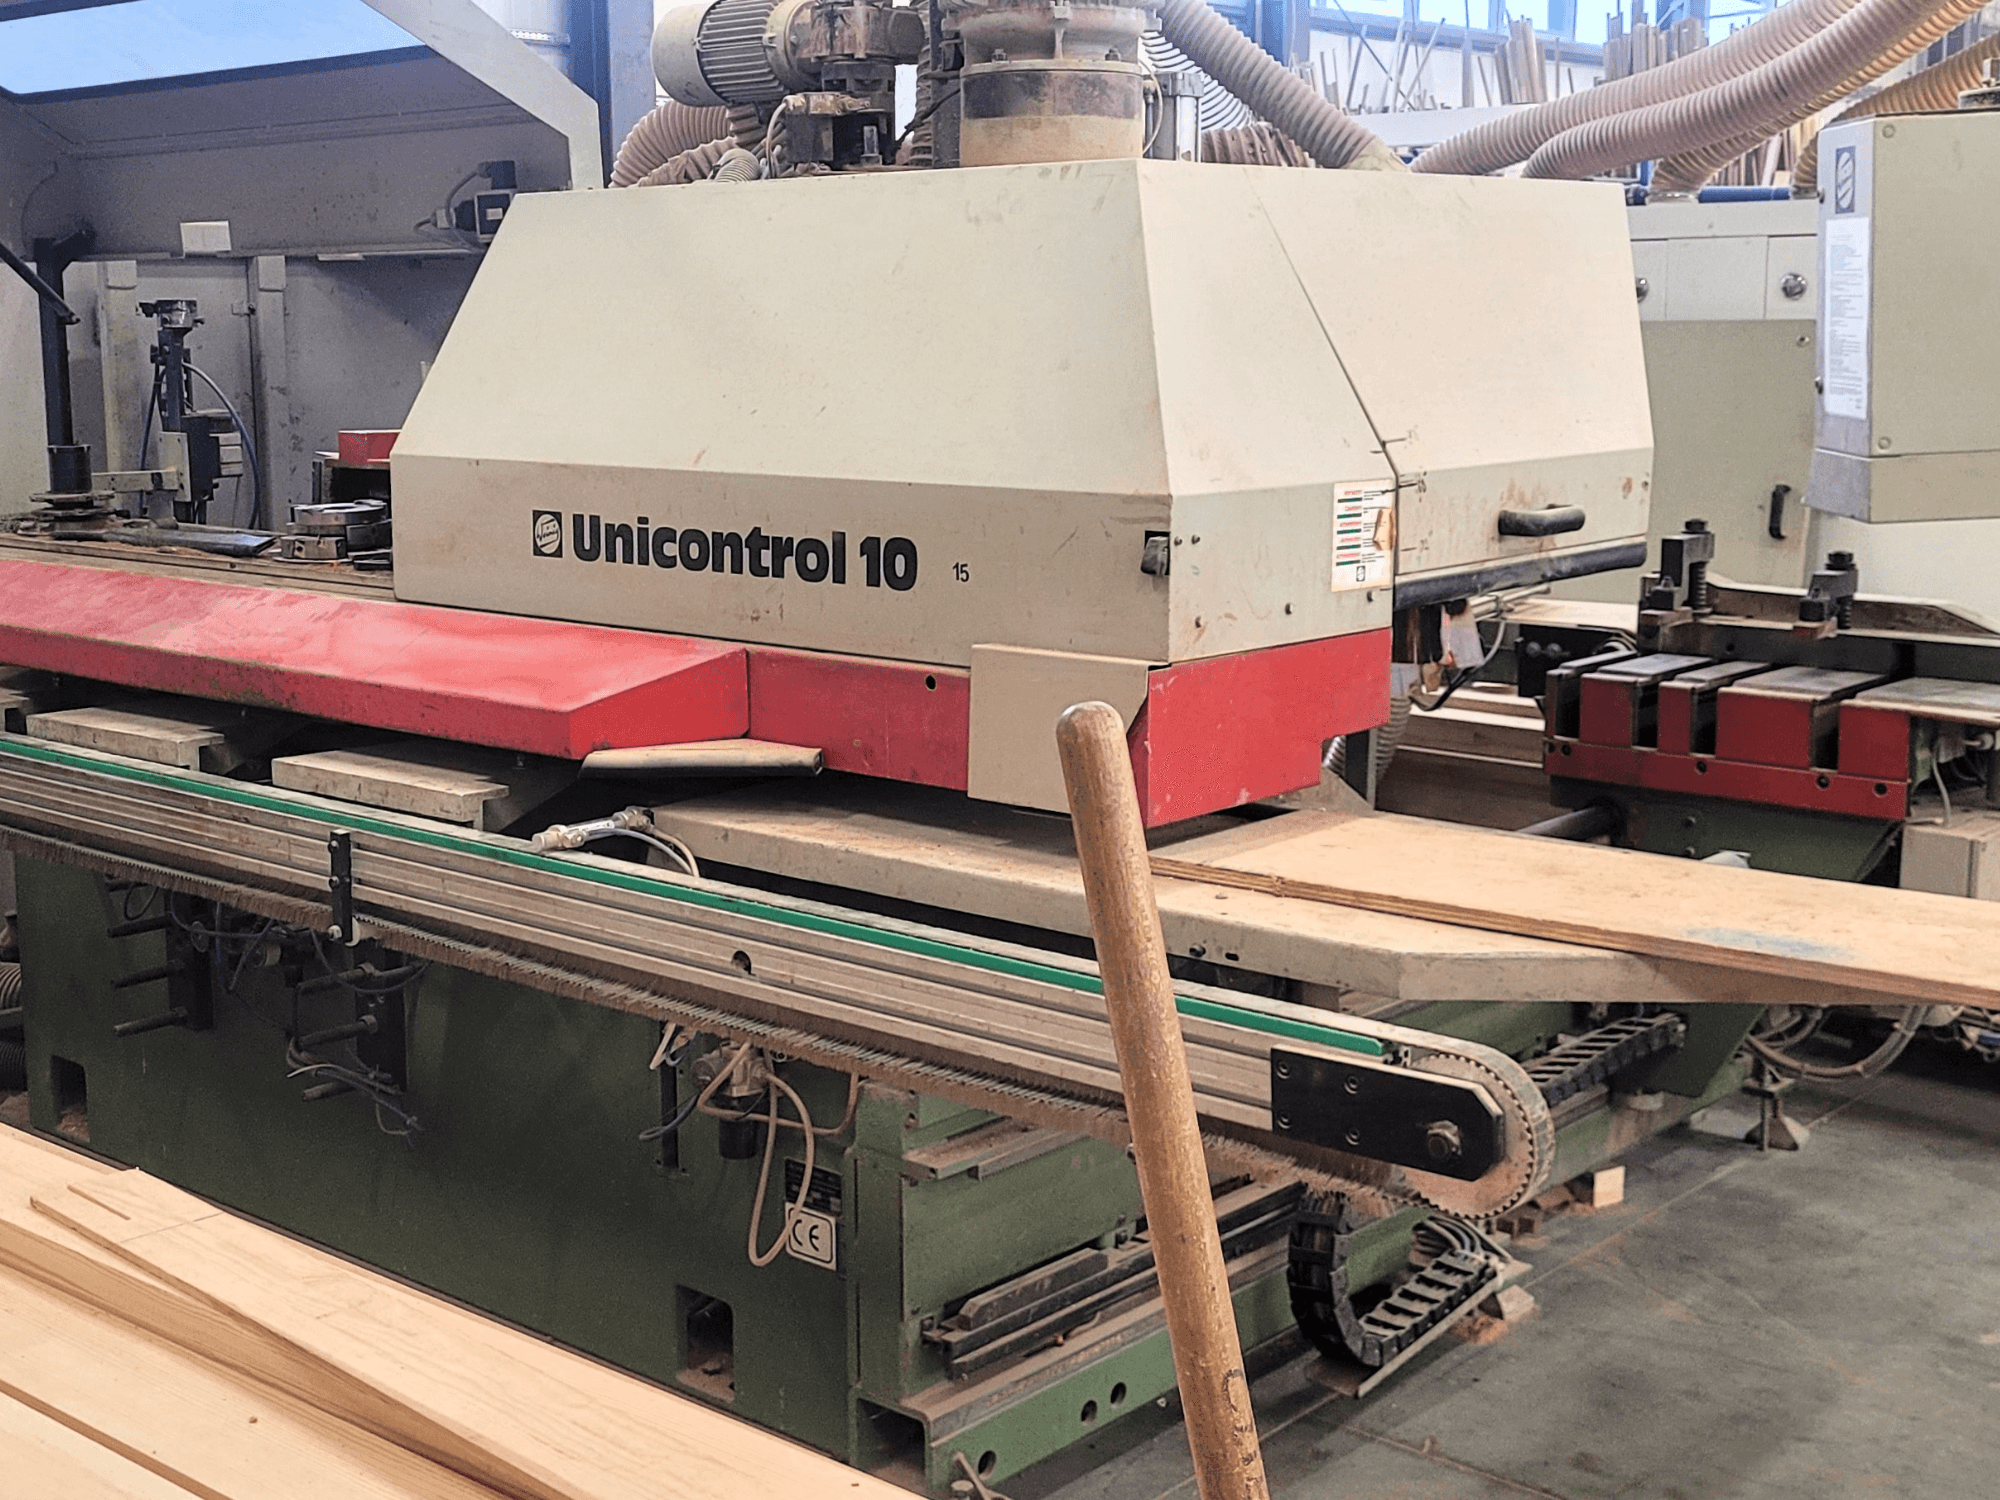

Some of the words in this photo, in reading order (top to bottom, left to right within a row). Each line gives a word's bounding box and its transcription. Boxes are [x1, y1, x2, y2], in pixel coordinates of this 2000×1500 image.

[572, 513, 846, 585] Unicontrol
[859, 536, 918, 591] 10
[952, 562, 970, 583] 15
